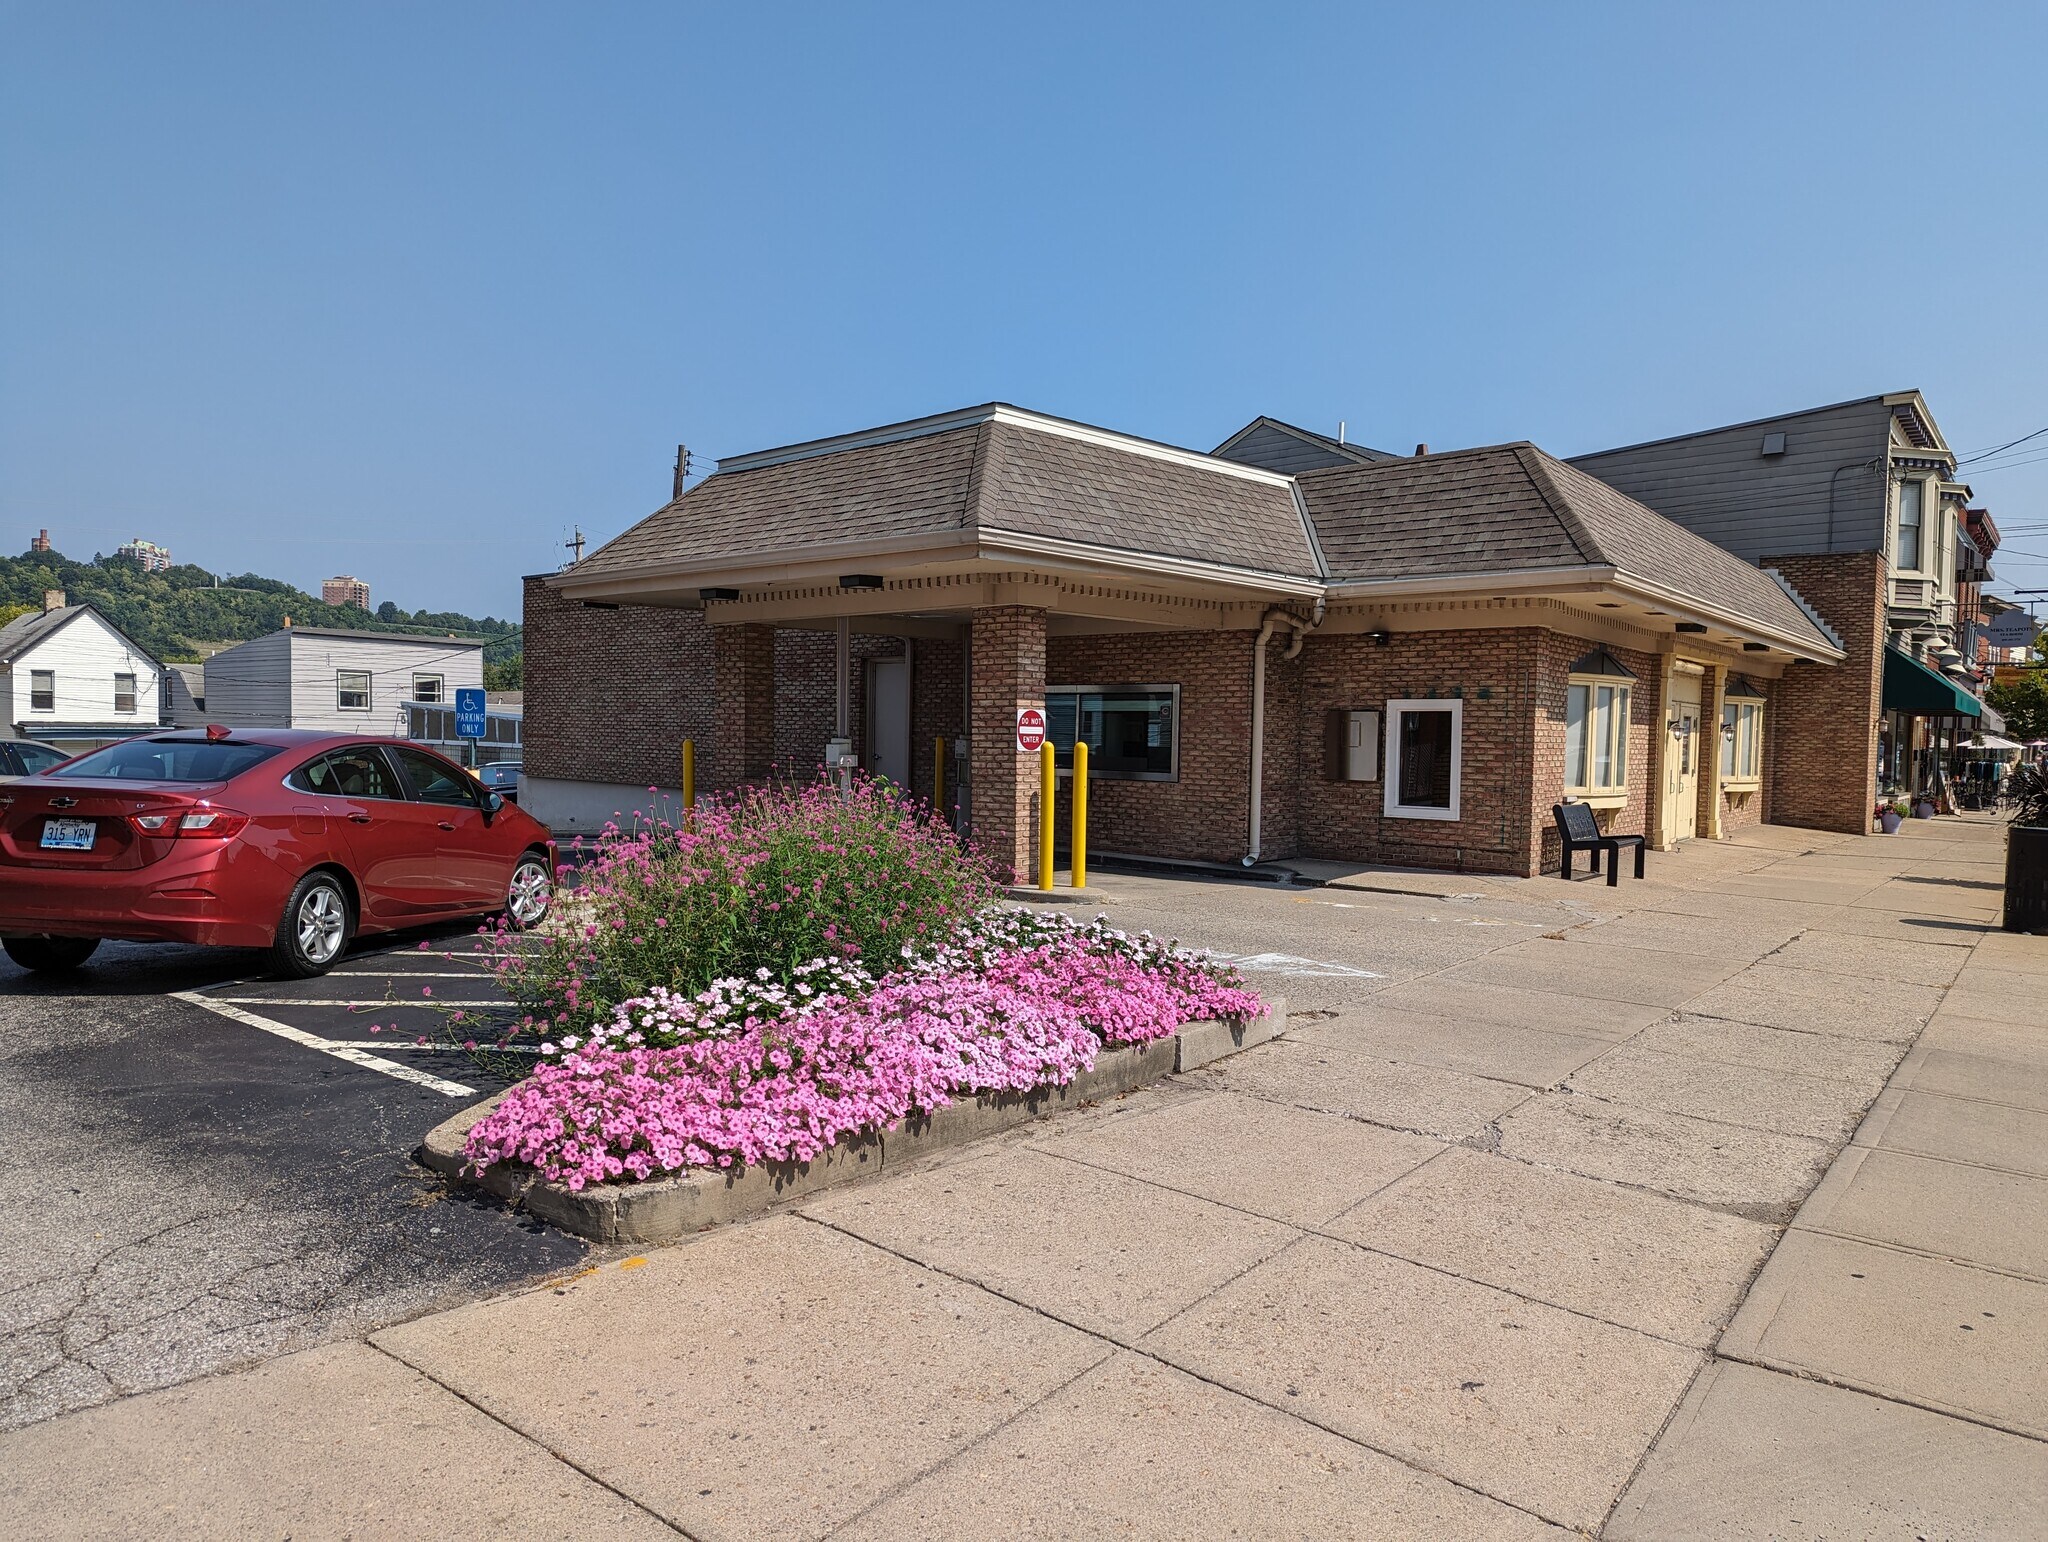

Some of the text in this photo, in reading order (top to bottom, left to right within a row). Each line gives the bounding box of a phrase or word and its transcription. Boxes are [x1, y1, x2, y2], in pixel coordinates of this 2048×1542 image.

[456, 712, 484, 722] PARKING
[462, 724, 478, 734] ONLY
[46, 827, 91, 842] 315 YRN
